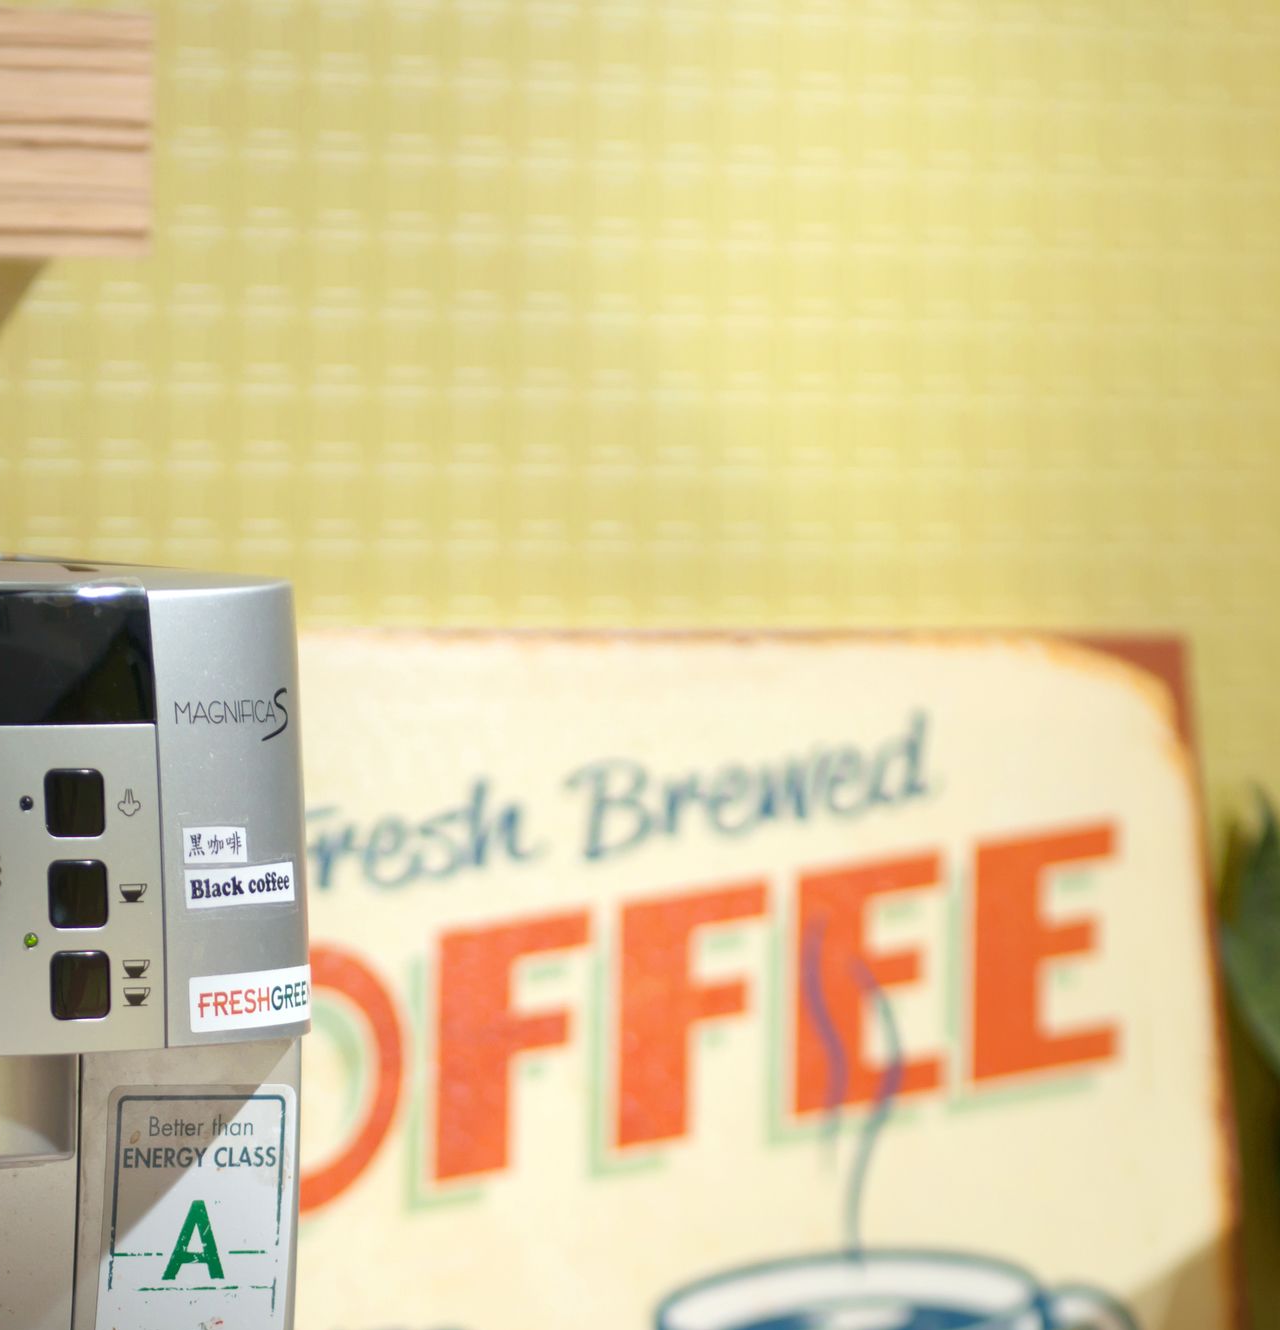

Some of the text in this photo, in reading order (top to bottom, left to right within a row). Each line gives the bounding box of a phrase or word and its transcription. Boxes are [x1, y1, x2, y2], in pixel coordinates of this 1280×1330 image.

[566, 710, 934, 862] Brewed
[190, 871, 290, 900] Black coffee
[198, 980, 310, 1018] FRESHGREE
[148, 1114, 254, 1137] Better than
[123, 1146, 276, 1169] ENERGY CLASS
[161, 1199, 225, 1281] A
